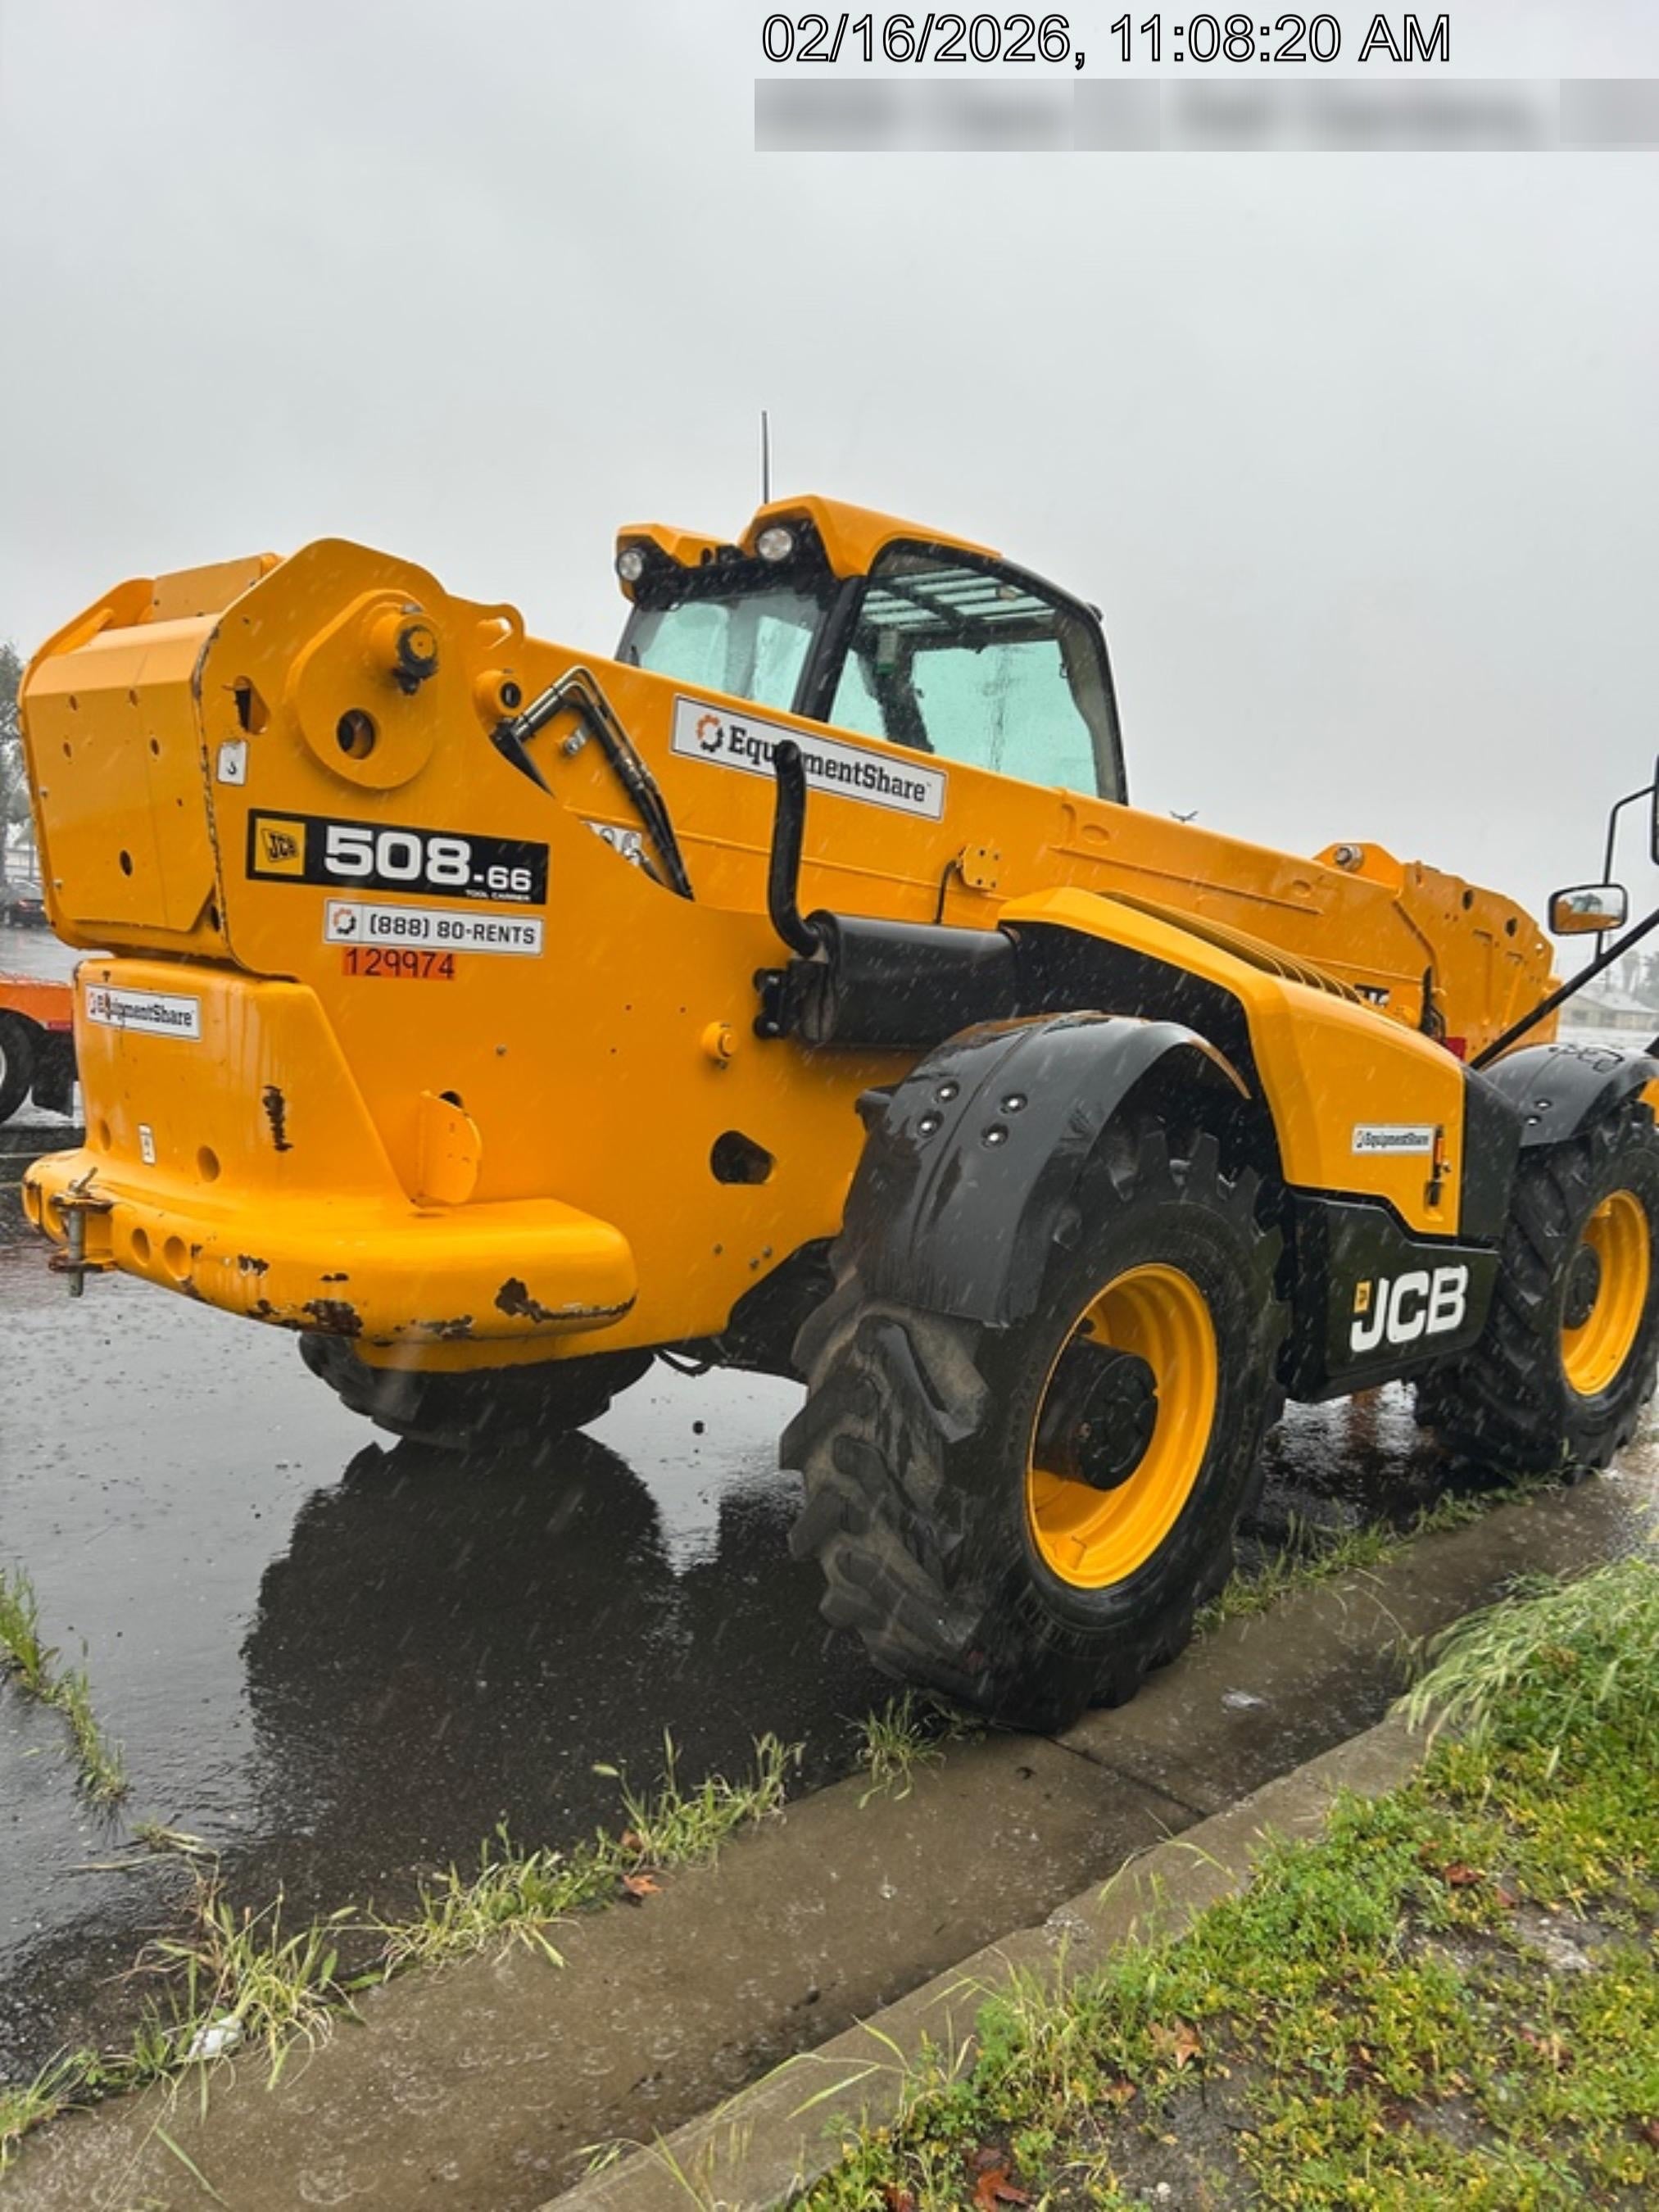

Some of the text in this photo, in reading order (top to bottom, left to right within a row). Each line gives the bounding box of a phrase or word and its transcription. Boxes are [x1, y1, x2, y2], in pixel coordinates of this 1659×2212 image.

[728, 724, 927, 803] EqumentShare
[369, 913, 535, 945] (888) 80-RENTS
[346, 949, 456, 977] 129974
[1350, 1265, 1468, 1352] JCB
